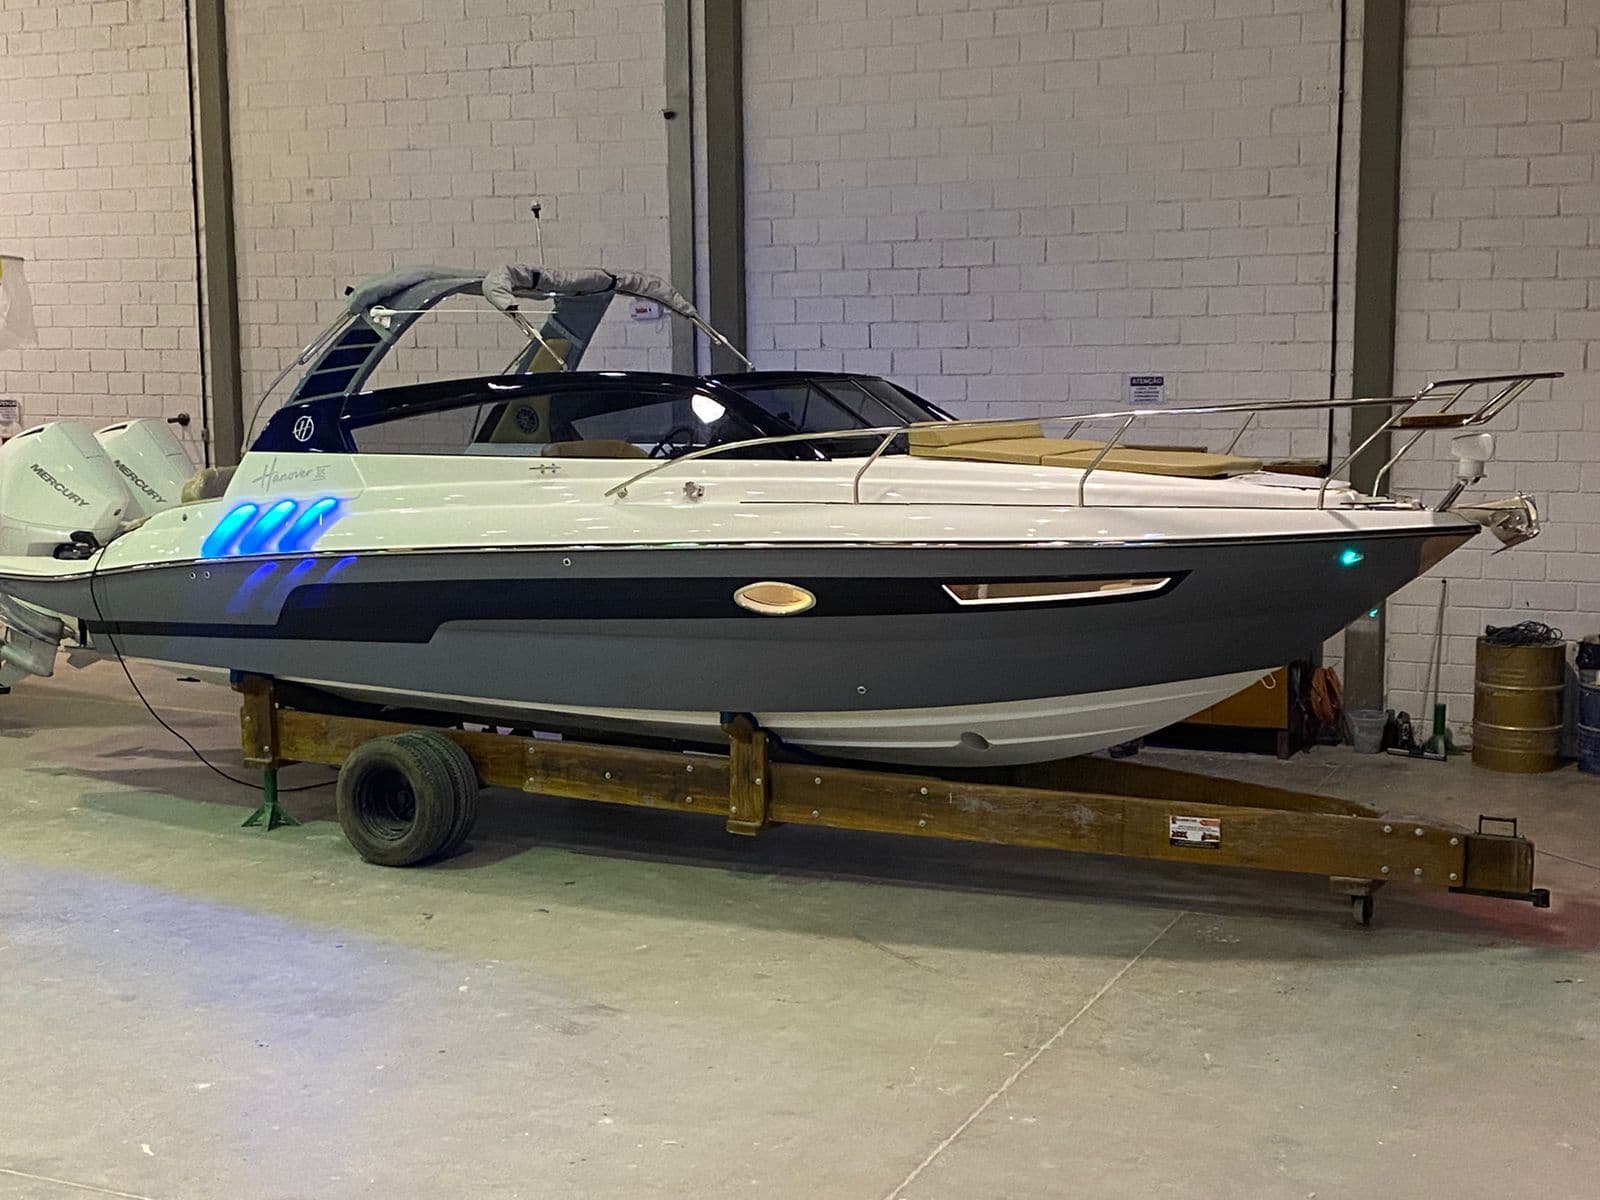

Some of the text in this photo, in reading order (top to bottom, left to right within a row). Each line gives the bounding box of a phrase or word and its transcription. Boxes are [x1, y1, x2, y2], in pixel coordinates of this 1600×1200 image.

[30, 463, 90, 506] MERCURY
[114, 459, 167, 503] MERCURY
[252, 456, 312, 492] Hanover
